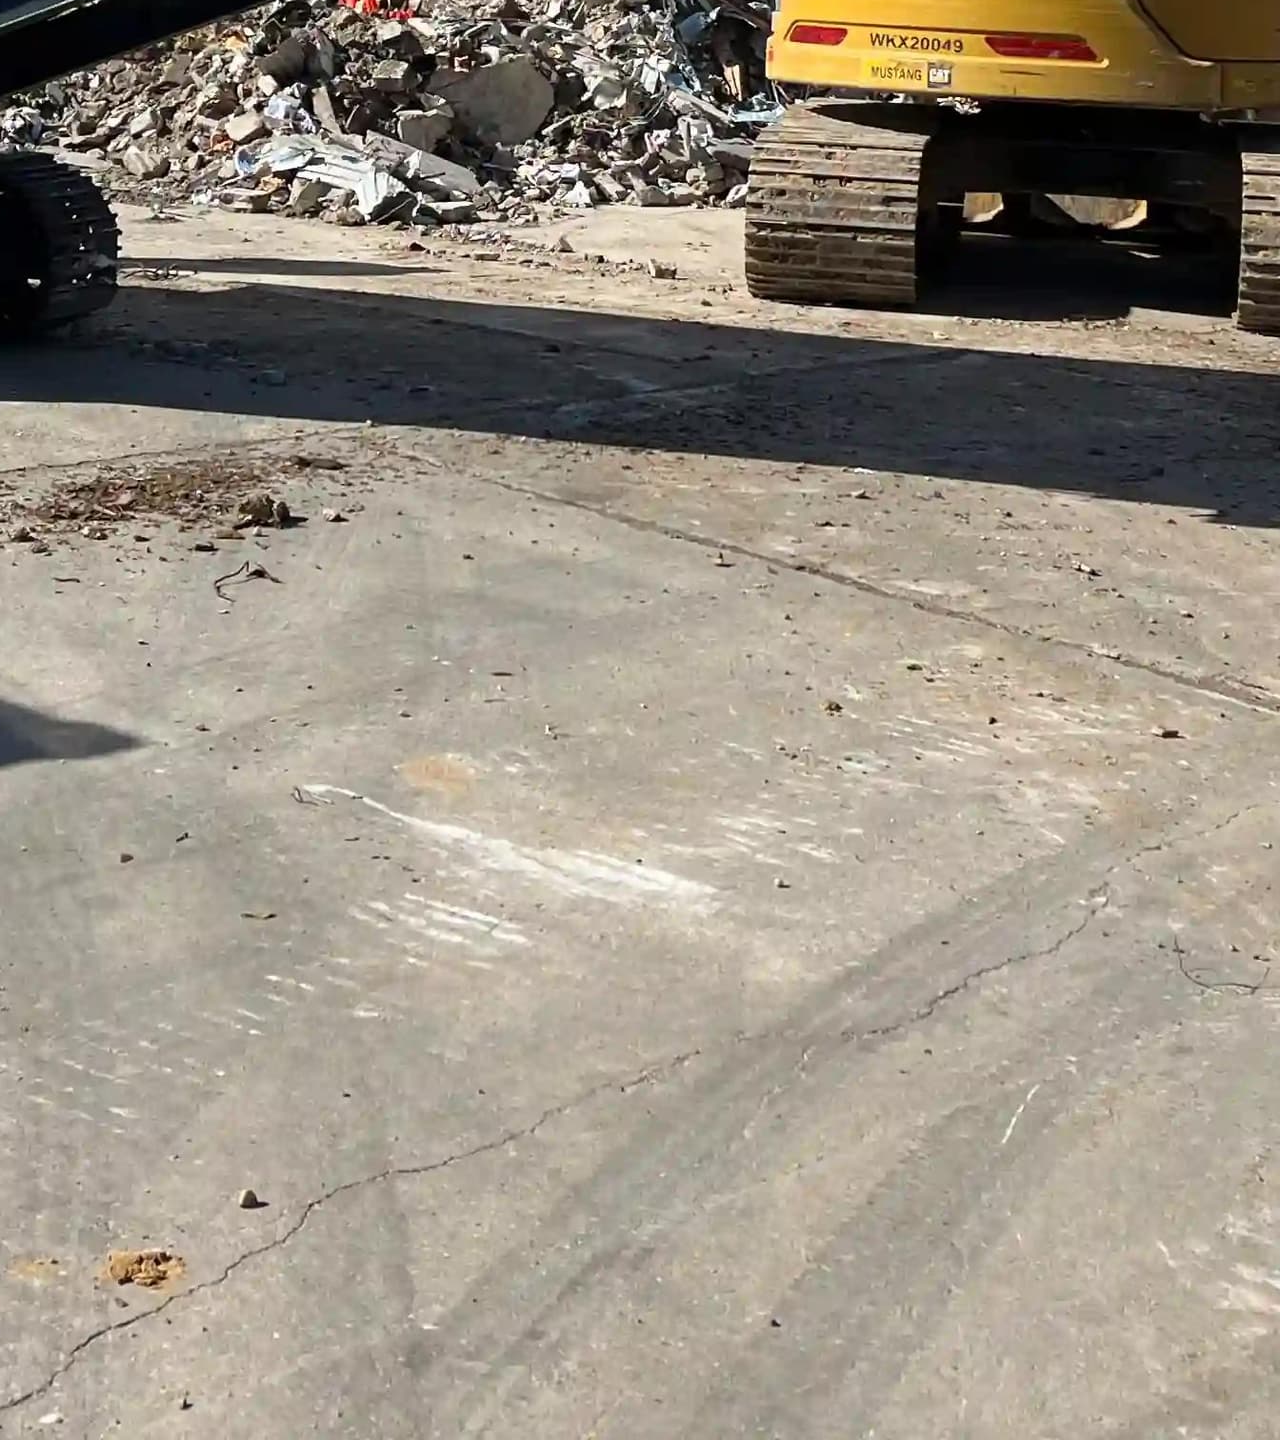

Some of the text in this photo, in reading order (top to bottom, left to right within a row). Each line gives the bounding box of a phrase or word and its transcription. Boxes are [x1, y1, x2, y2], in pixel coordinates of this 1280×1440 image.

[870, 32, 964, 53] WKX20049
[871, 65, 951, 84] MUSTANG CAT
